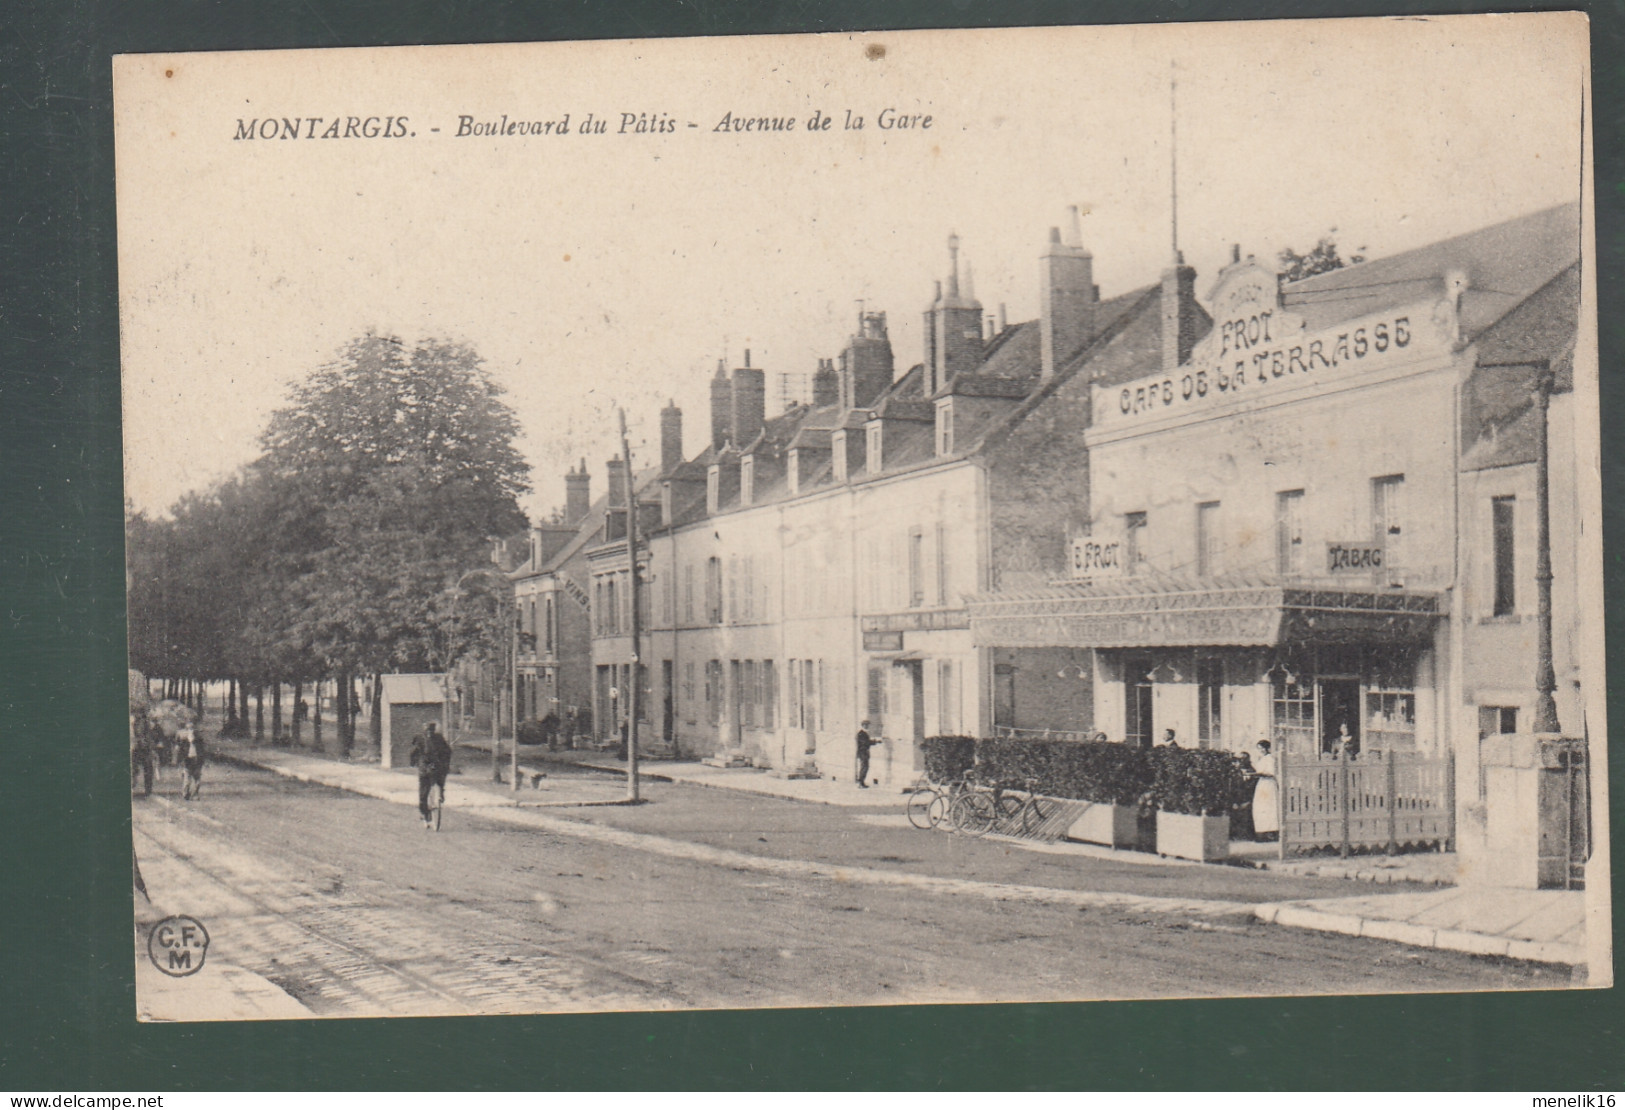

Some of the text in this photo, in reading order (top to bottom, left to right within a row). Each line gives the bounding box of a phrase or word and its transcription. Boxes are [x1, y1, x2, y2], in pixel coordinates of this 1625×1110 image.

[1182, 370, 1208, 400] DE
[1217, 359, 1246, 392] LA
[1253, 316, 1412, 384] TERRASSE
[1220, 309, 1273, 358] FROT
[565, 579, 590, 605] VINS
